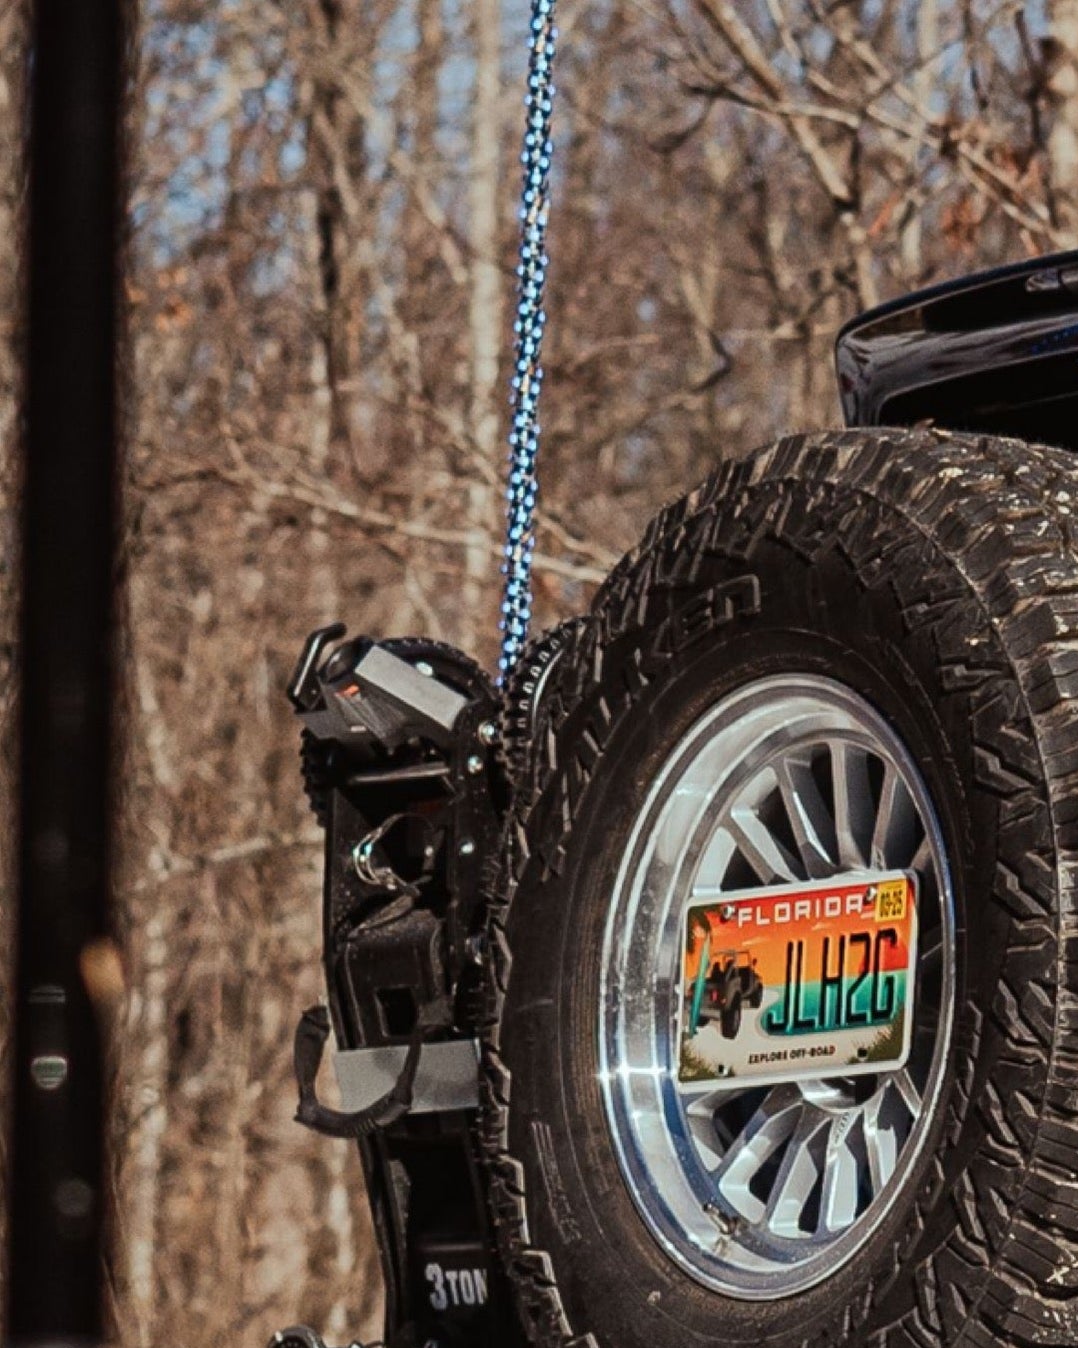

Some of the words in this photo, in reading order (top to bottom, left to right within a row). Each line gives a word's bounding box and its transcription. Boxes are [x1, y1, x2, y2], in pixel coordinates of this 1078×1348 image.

[738, 893, 864, 928] FLORIDA
[749, 1049, 788, 1064] EXPLORE
[790, 1044, 836, 1060] OFF-ROAD
